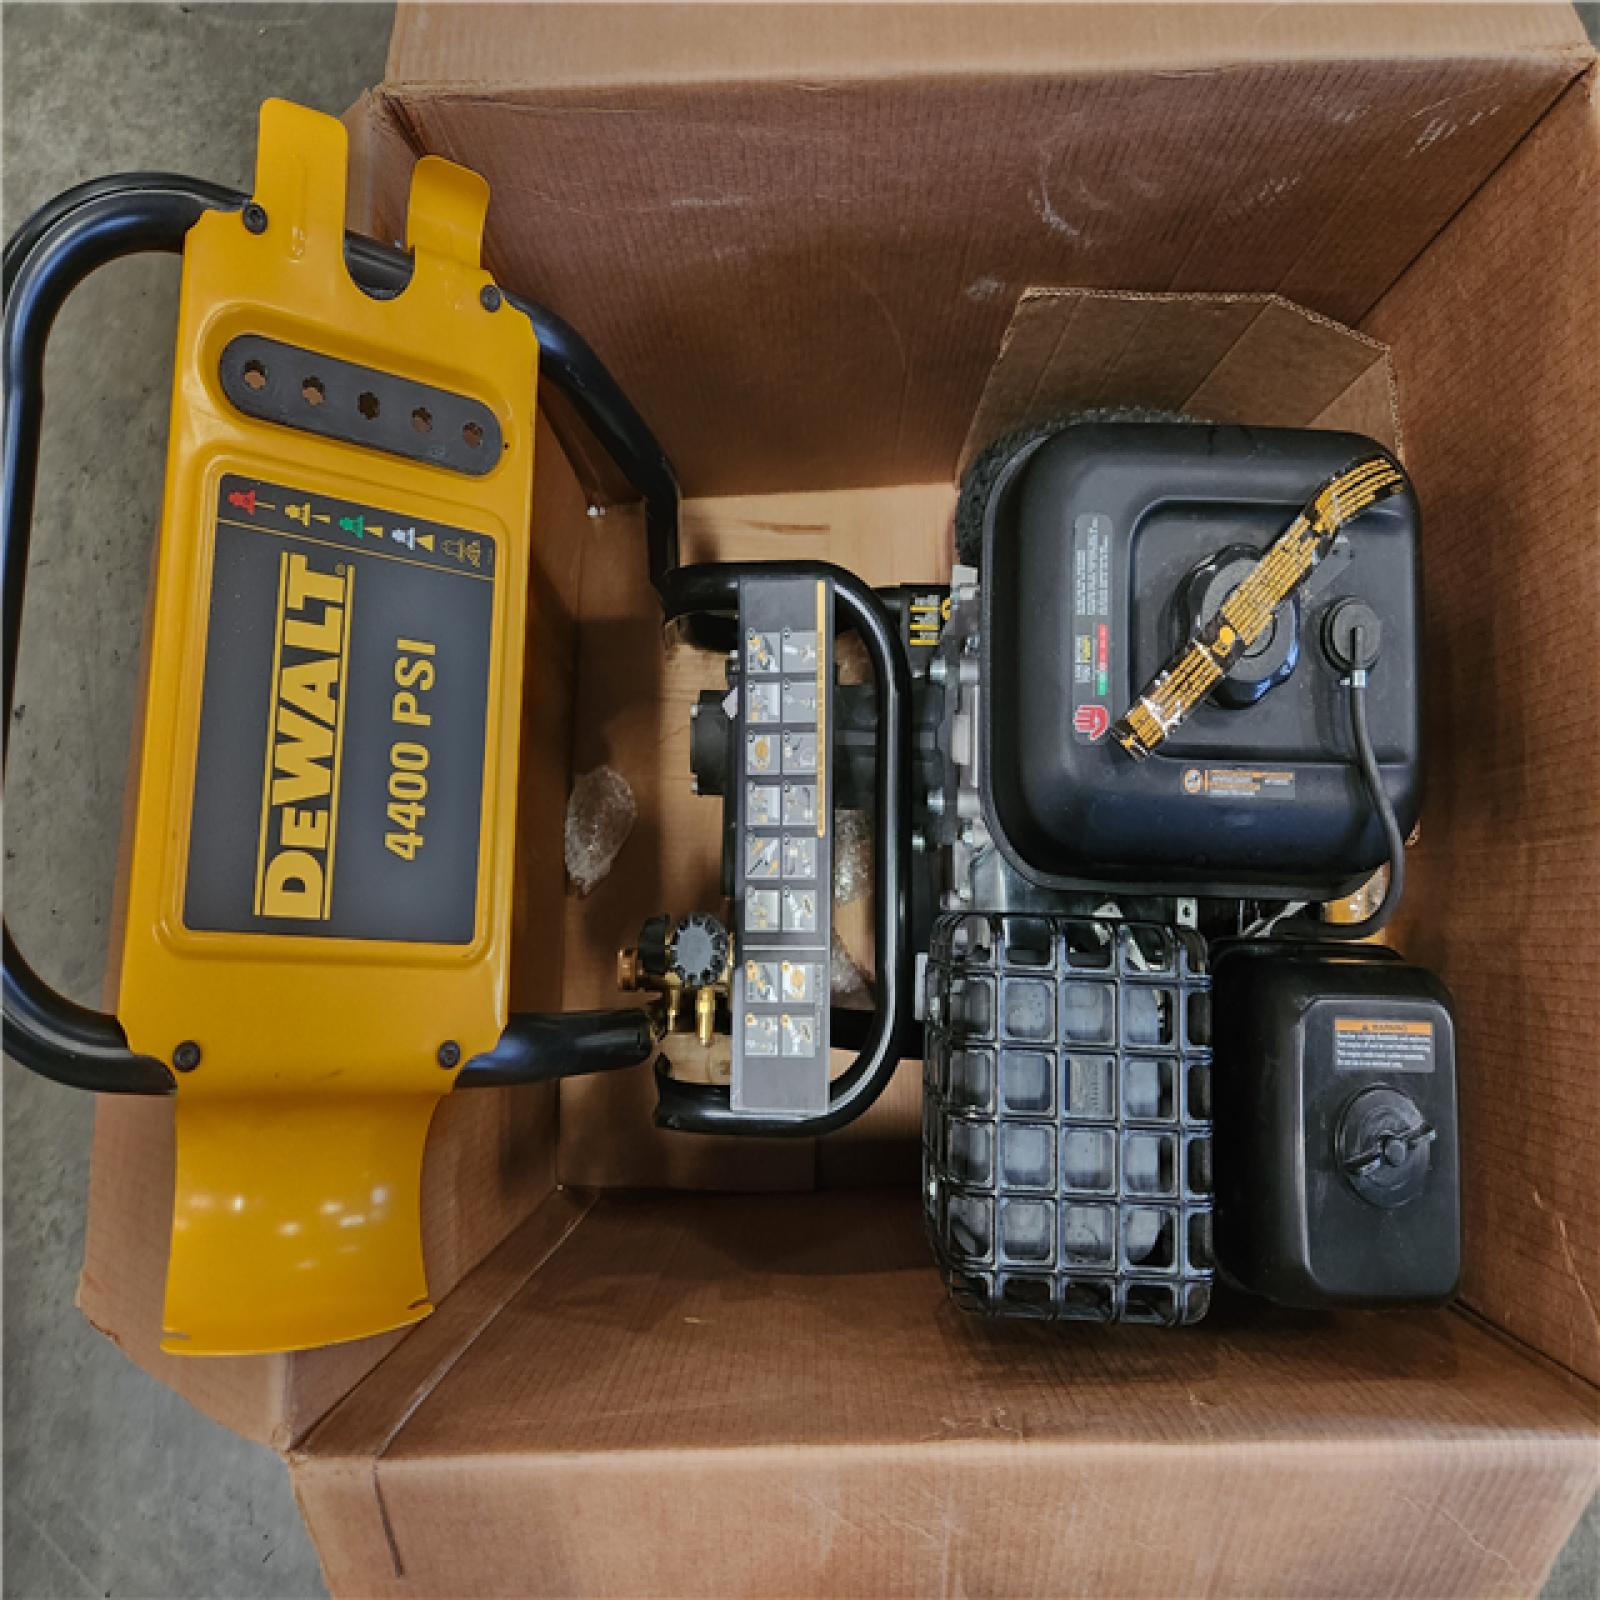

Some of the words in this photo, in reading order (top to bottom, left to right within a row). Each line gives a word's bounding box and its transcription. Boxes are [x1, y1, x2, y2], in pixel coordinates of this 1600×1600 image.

[261, 553, 345, 919] DEWALT
[391, 637, 436, 727] PSI
[384, 741, 430, 861] 4400
